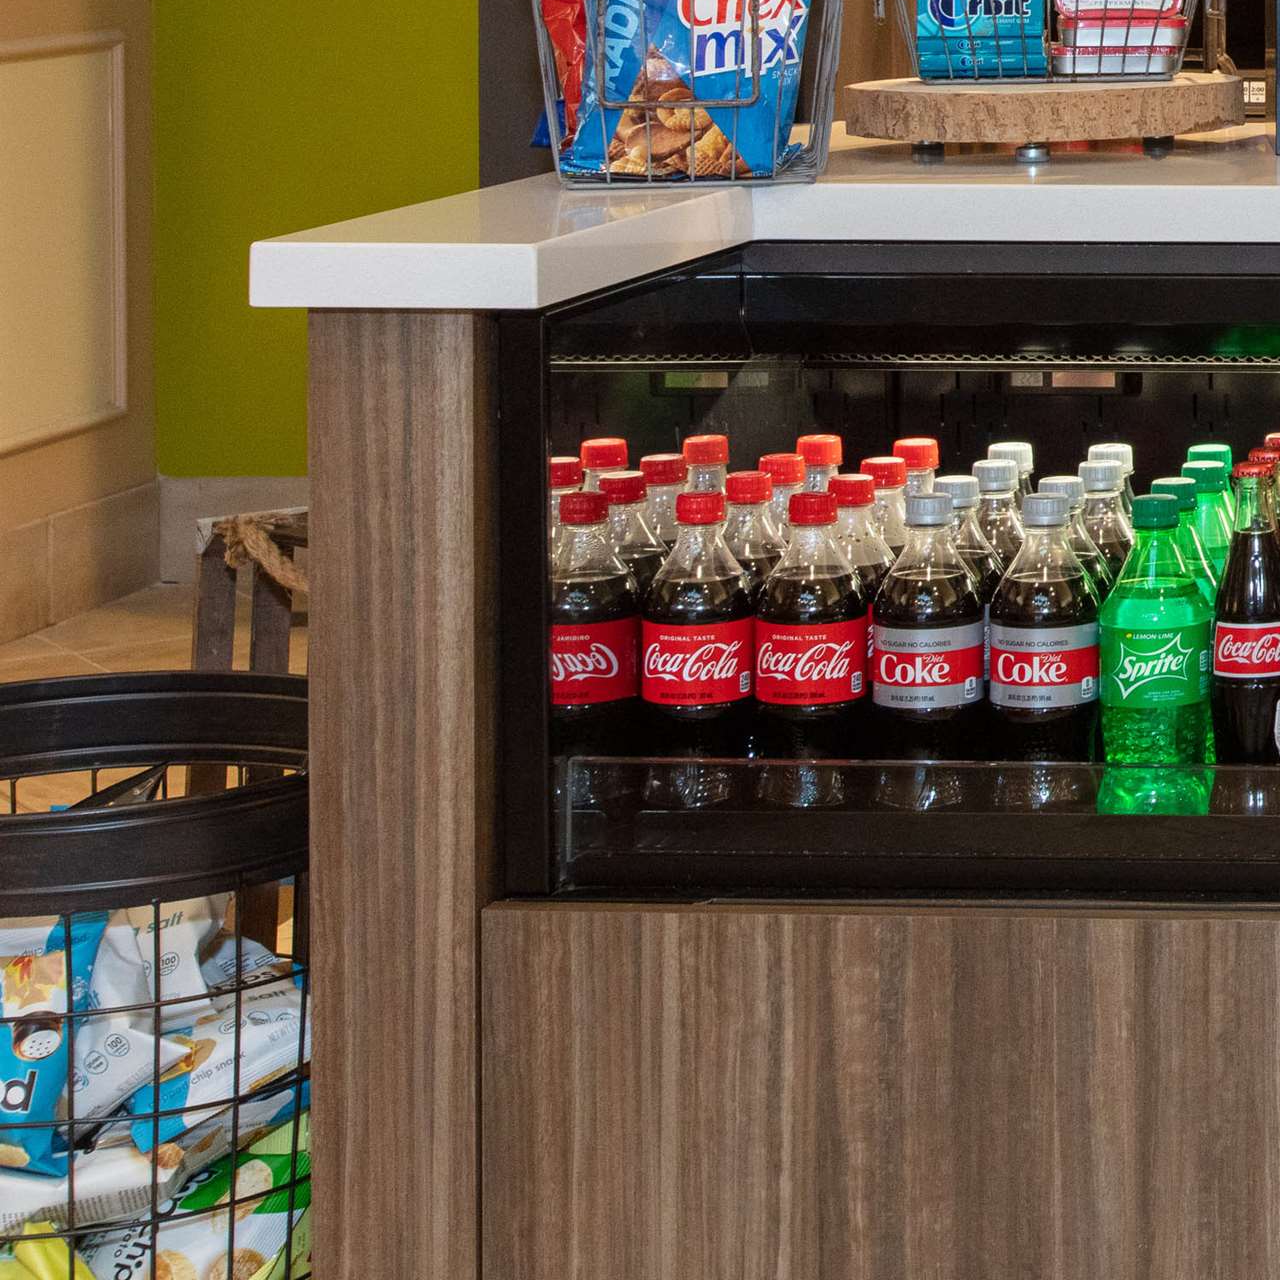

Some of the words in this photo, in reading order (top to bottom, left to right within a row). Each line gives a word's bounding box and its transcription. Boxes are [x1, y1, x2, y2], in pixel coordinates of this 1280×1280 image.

[908, 640, 917, 648] NO
[918, 640, 952, 648] CALORIES
[1025, 640, 1034, 648] NO
[644, 640, 743, 682] Coca-Cola
[756, 639, 855, 682] Coca-Cola
[880, 653, 951, 685] Coke
[997, 653, 1067, 685] Coke
[1119, 651, 1183, 682] Sprite
[160, 955, 177, 967] 100
[107, 1036, 123, 1050] 100
